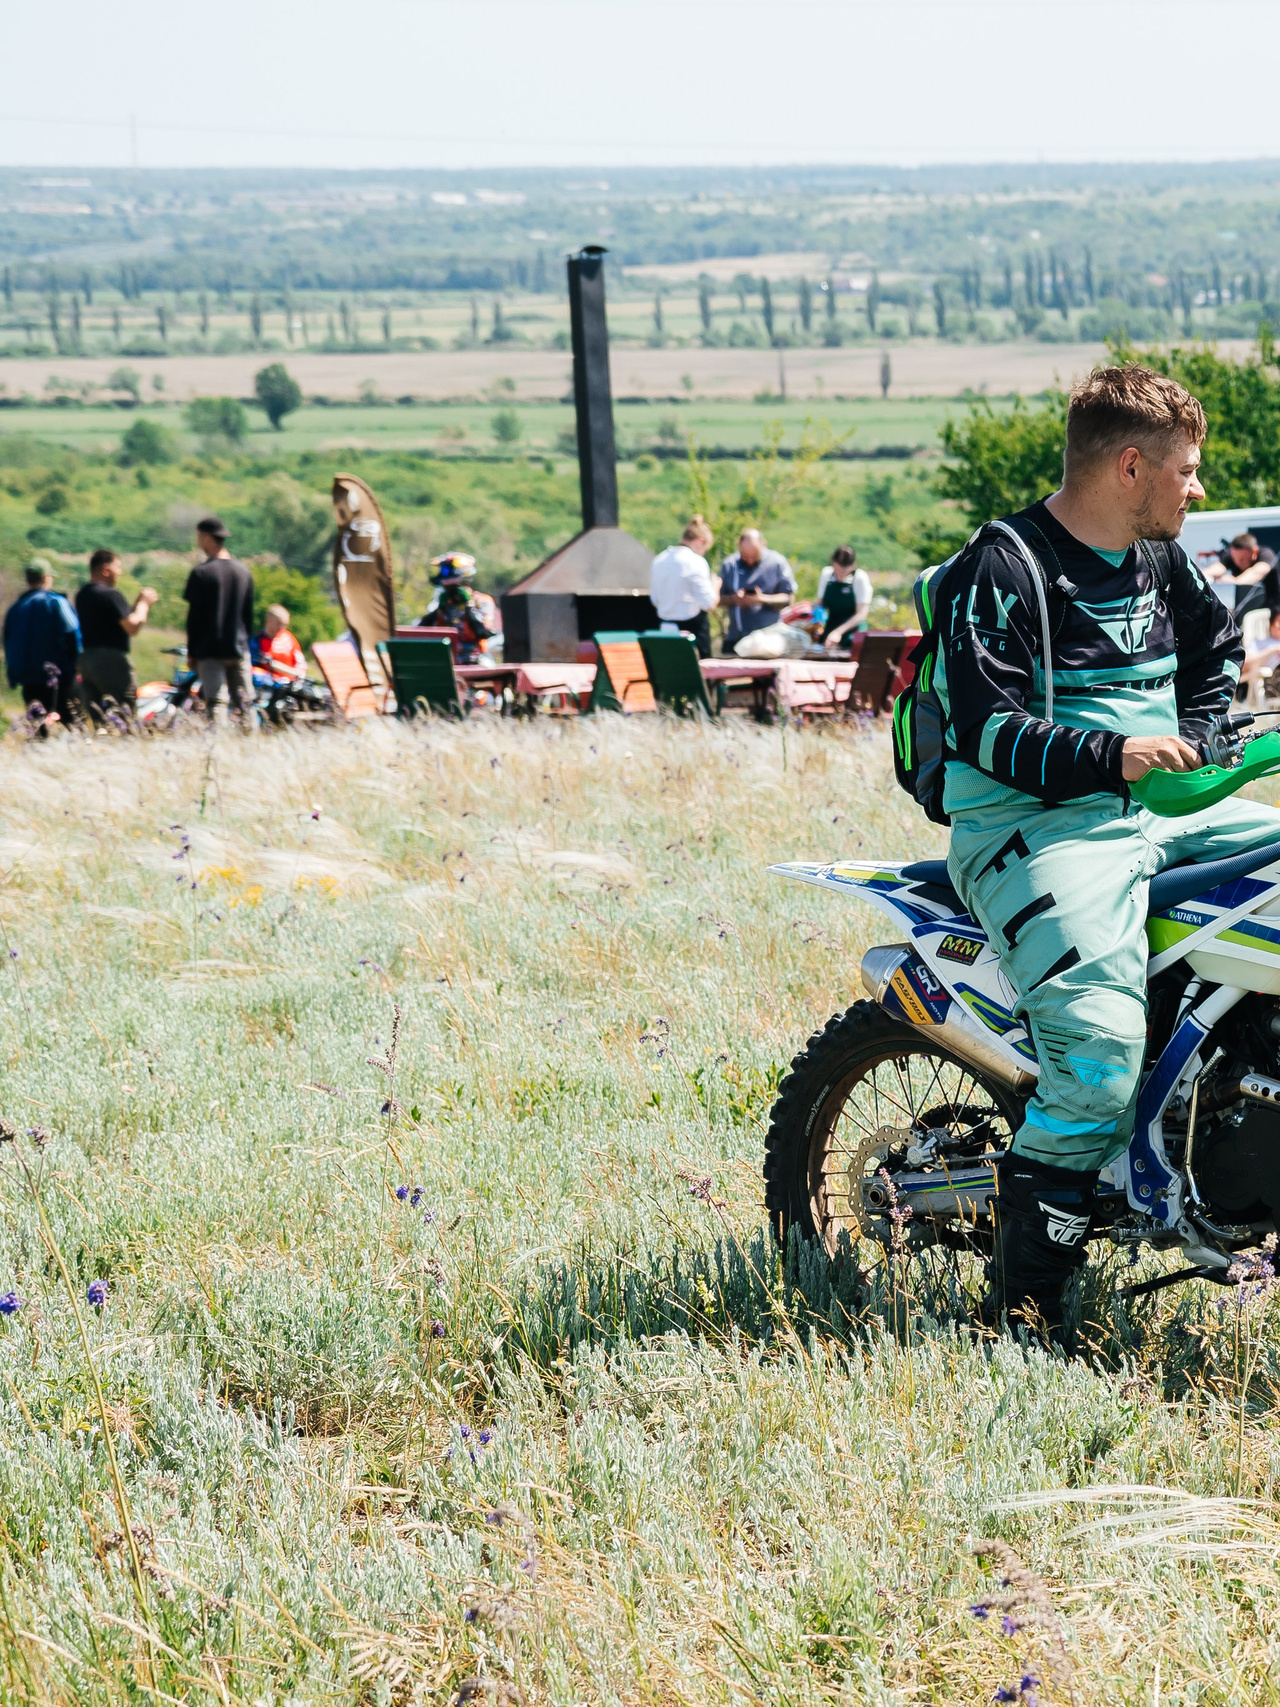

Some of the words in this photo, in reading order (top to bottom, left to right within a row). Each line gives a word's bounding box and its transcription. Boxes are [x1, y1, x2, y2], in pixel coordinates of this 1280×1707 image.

[949, 584, 1019, 637] FLY
[1174, 911, 1202, 924] ATHENA
[929, 1002, 943, 1021] MOTO
